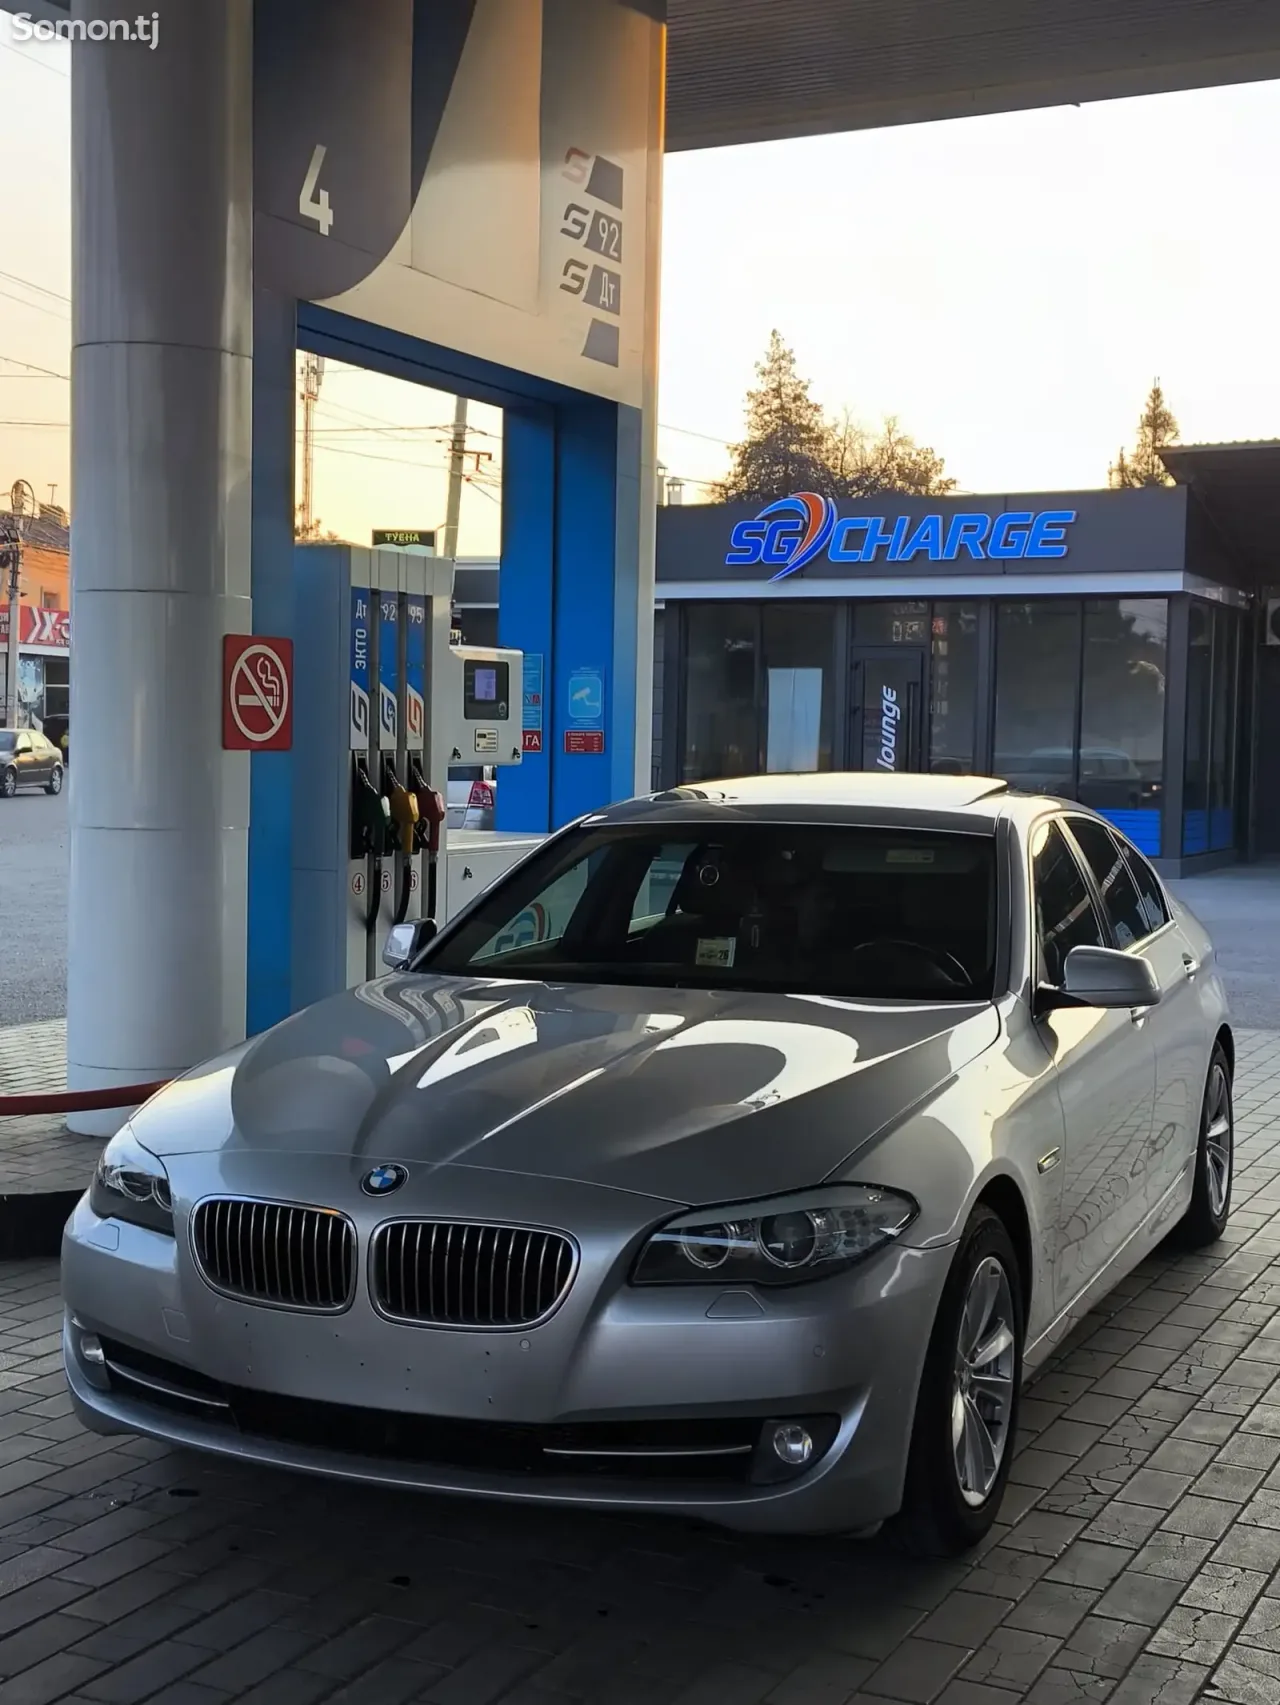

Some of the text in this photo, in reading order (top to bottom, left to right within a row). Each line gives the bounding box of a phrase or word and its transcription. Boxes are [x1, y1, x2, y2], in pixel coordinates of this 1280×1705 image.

[299, 143, 334, 236] 4
[599, 217, 620, 258] 92
[726, 510, 1077, 565] SG CHARGE
[382, 603, 396, 621] 92
[410, 605, 423, 624] 95
[354, 628, 367, 670] ЭКТО
[876, 685, 901, 772] lounge
[354, 876, 362, 892] 4
[382, 874, 389, 890] 5
